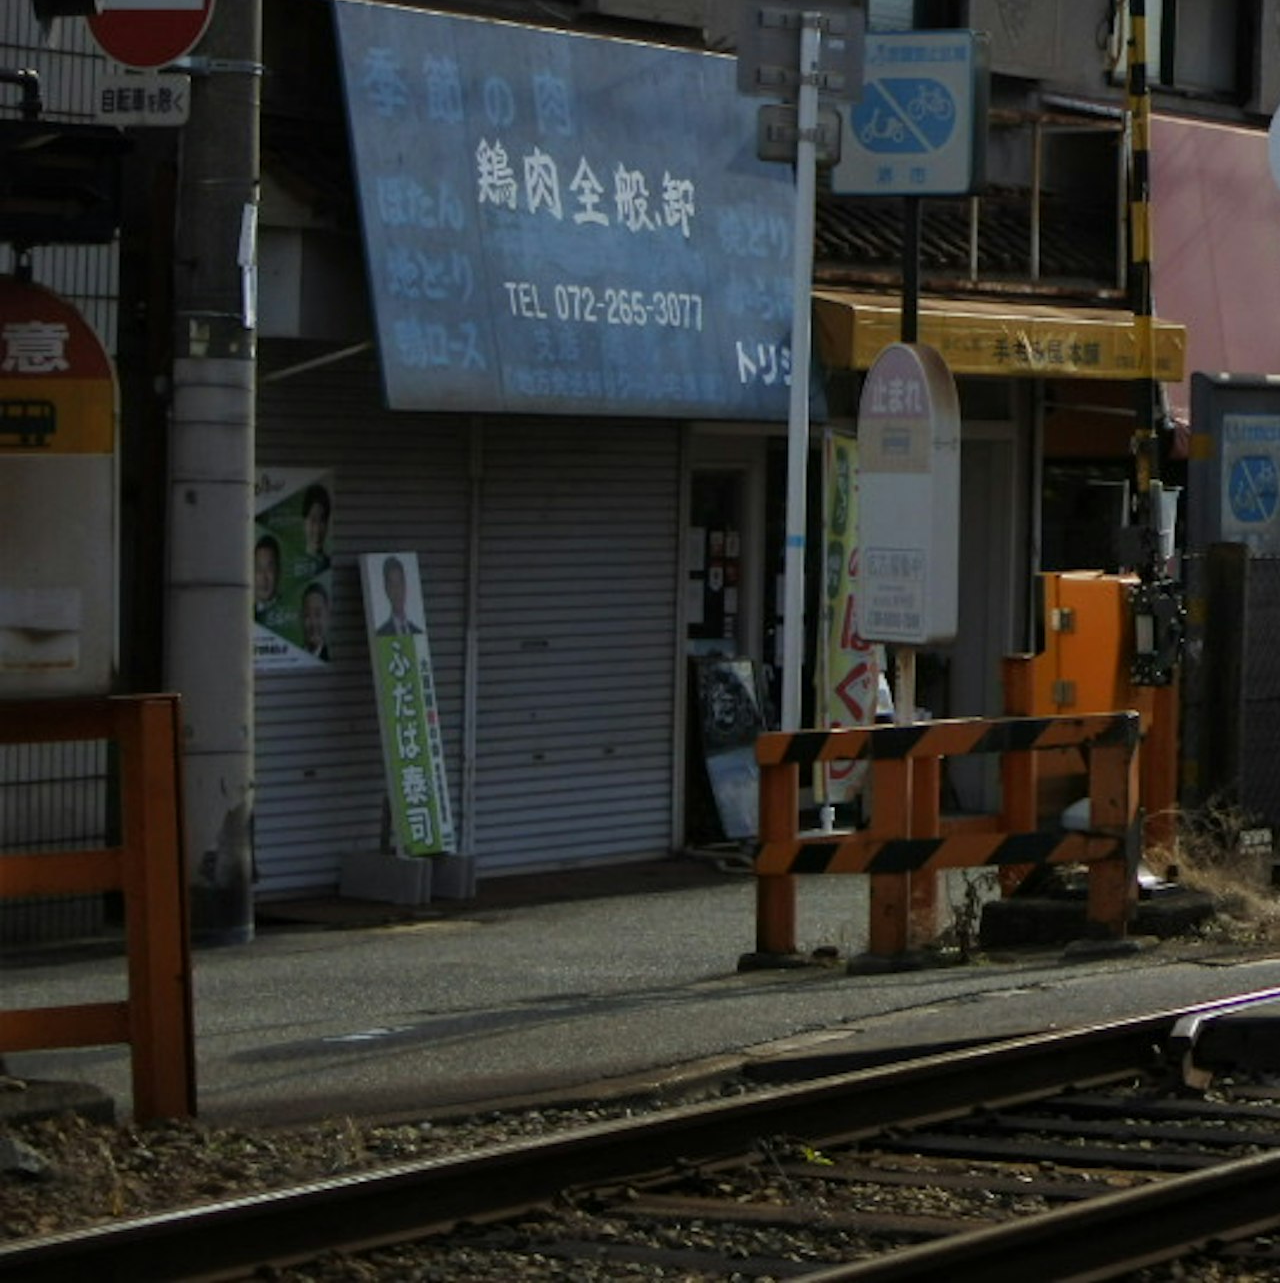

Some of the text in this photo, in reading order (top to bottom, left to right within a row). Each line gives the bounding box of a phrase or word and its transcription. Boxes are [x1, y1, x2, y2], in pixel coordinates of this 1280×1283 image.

[503, 281, 704, 333] TEL 072-265-3077
[871, 379, 923, 414] 止まれ
